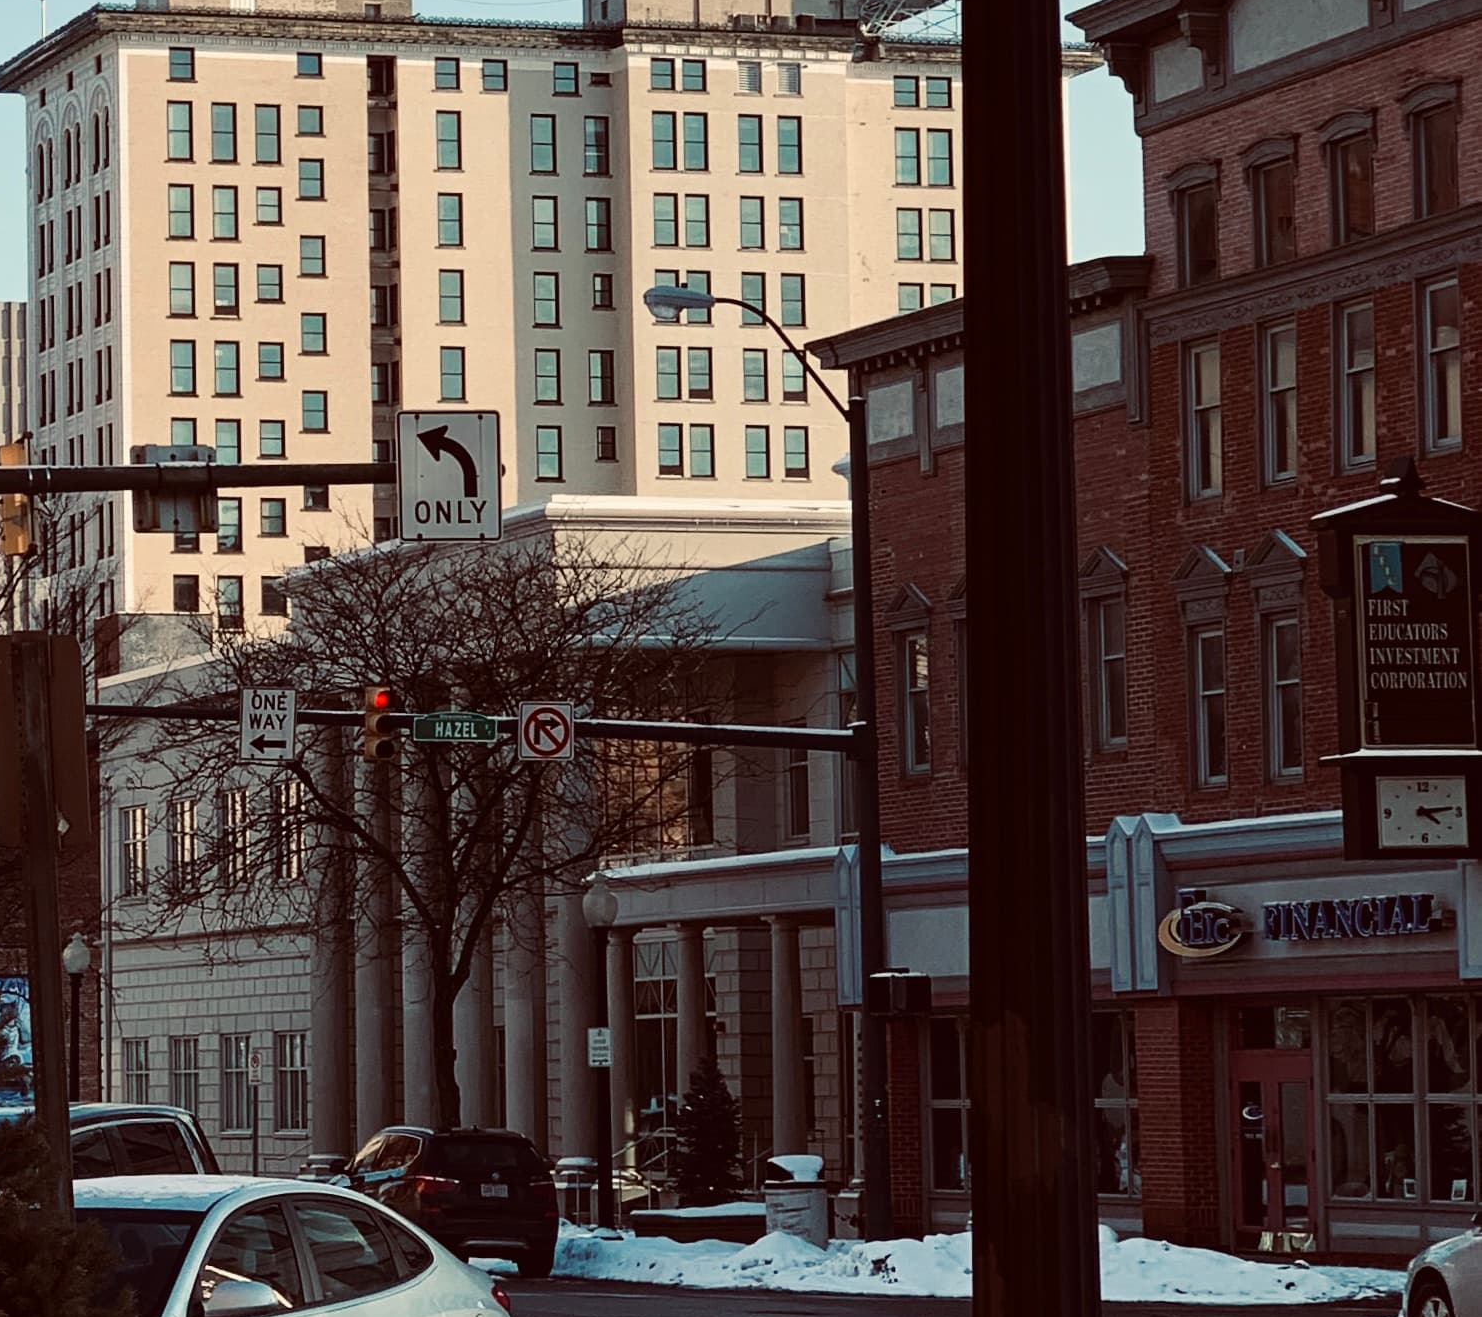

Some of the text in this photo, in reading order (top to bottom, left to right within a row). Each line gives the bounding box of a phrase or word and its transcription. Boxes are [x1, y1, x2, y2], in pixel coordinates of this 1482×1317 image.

[414, 500, 487, 524] ONLY
[1368, 599, 1409, 616] FIRST
[1368, 623, 1449, 641] EDUCATORS
[1369, 647, 1460, 665] INVESTMENT
[1370, 671, 1467, 689] CORPORATION
[251, 694, 288, 710] ONE
[249, 713, 287, 730] WAY
[434, 721, 478, 738] HAZEL
[1417, 781, 1430, 793] 12
[1383, 808, 1392, 820] 9
[1454, 806, 1463, 819] 3
[1421, 832, 1429, 843] 6
[1264, 892, 1434, 941] FINANCIAL
